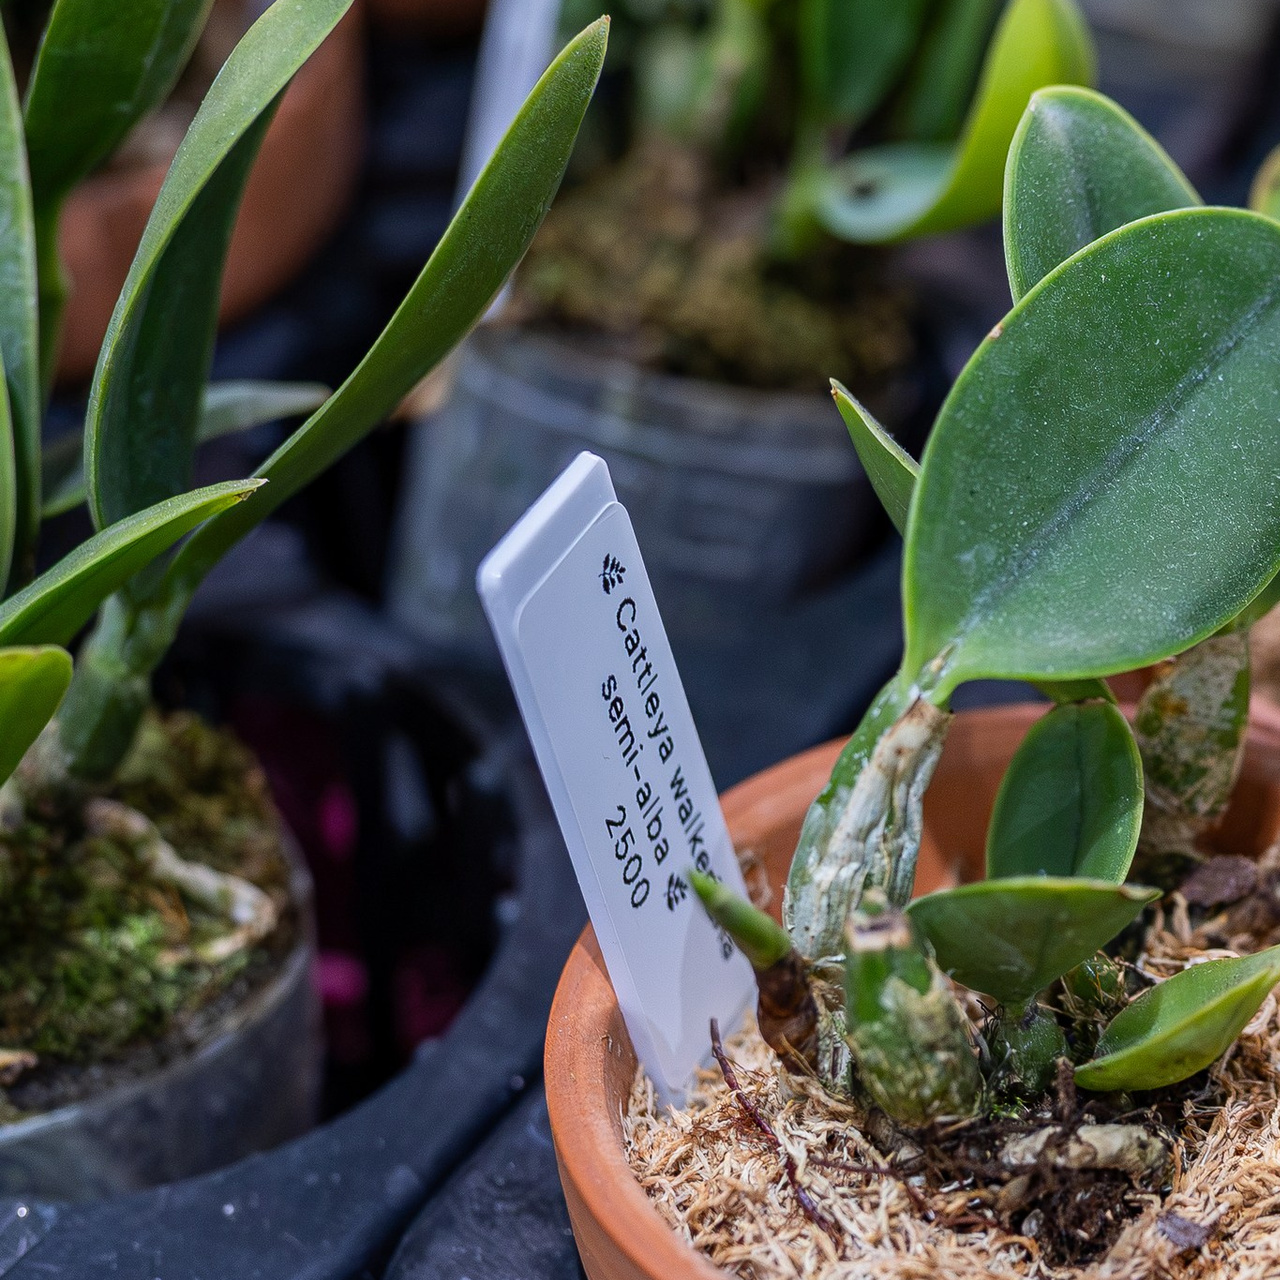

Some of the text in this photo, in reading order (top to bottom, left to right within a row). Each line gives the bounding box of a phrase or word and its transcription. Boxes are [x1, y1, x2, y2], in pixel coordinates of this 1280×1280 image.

[615, 595, 675, 764] Cattleya
[601, 673, 671, 866] semi-alba
[604, 804, 651, 910] 2500
